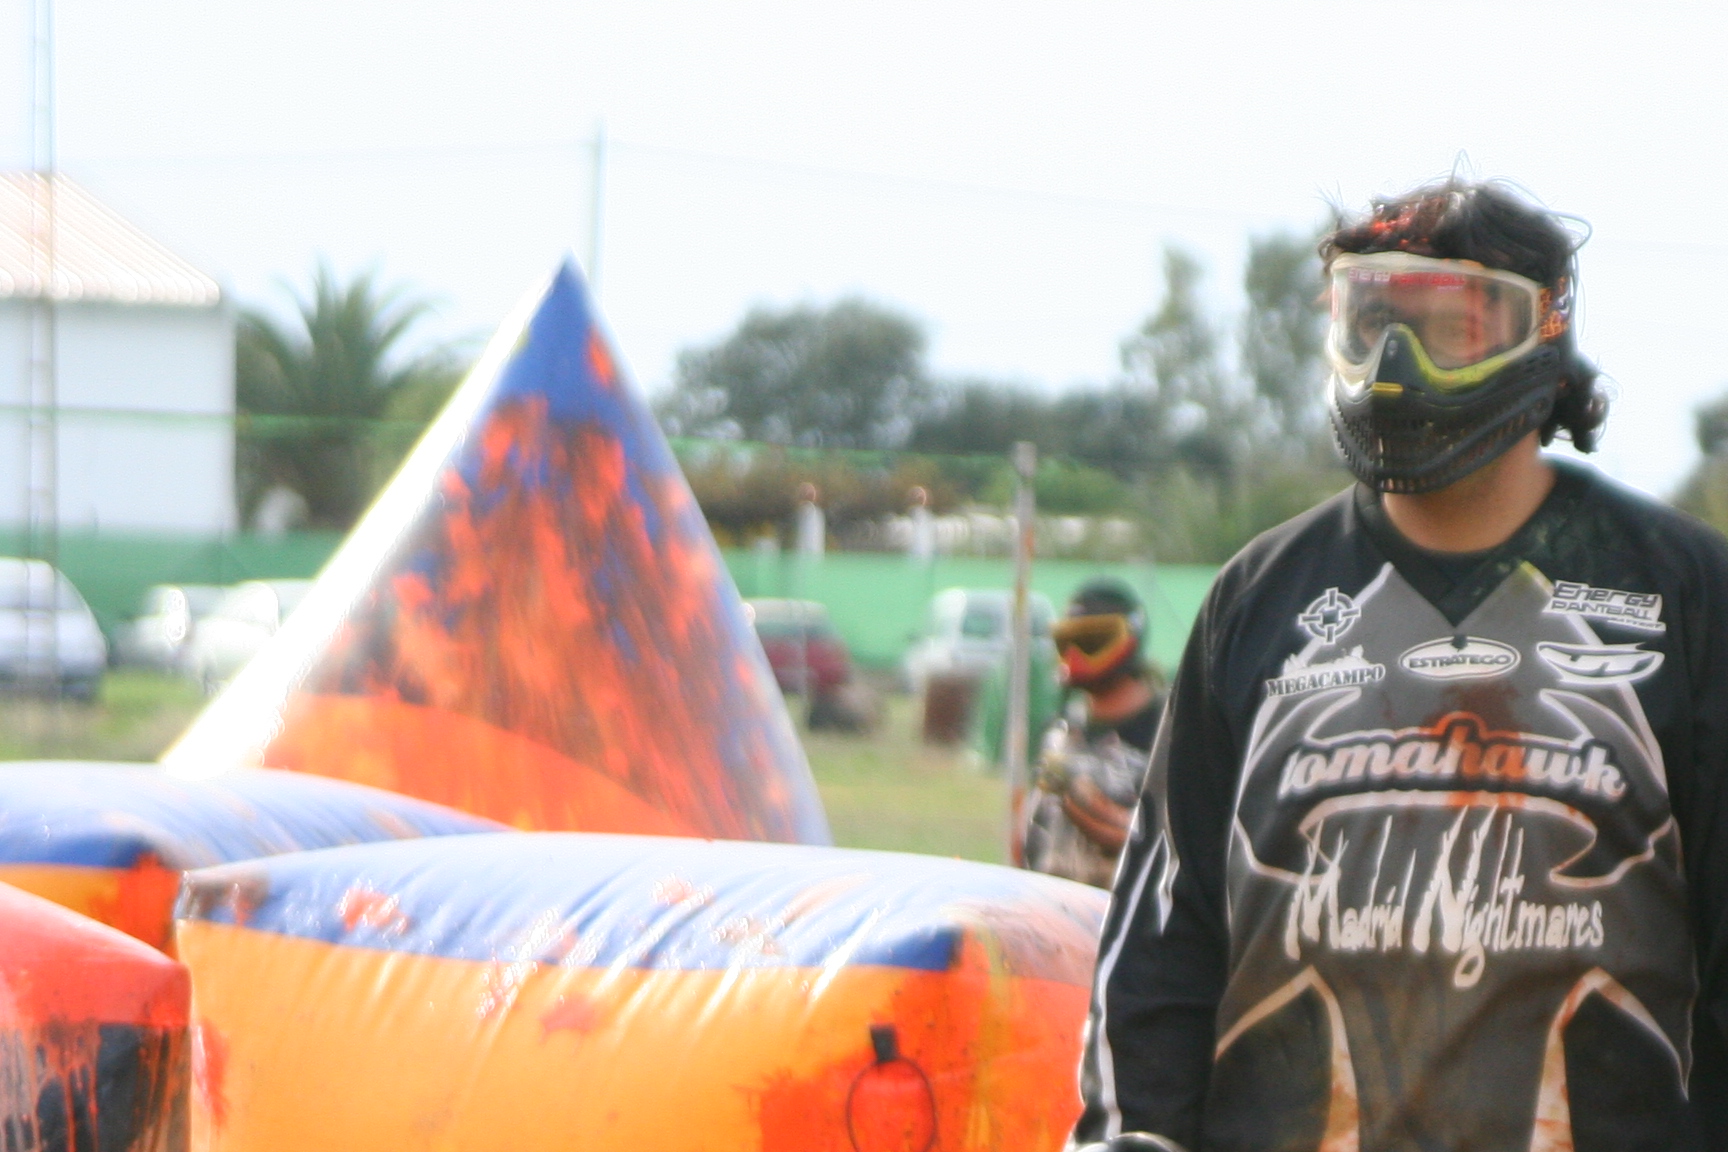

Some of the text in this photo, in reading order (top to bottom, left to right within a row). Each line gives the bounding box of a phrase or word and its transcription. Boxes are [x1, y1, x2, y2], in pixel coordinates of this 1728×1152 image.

[1266, 664, 1385, 698] MEGACAMPO
[1409, 653, 1512, 669] ESTRATEGO
[1278, 725, 1627, 800] tomahawk
[1285, 803, 1604, 989] Madrid Nightmares
